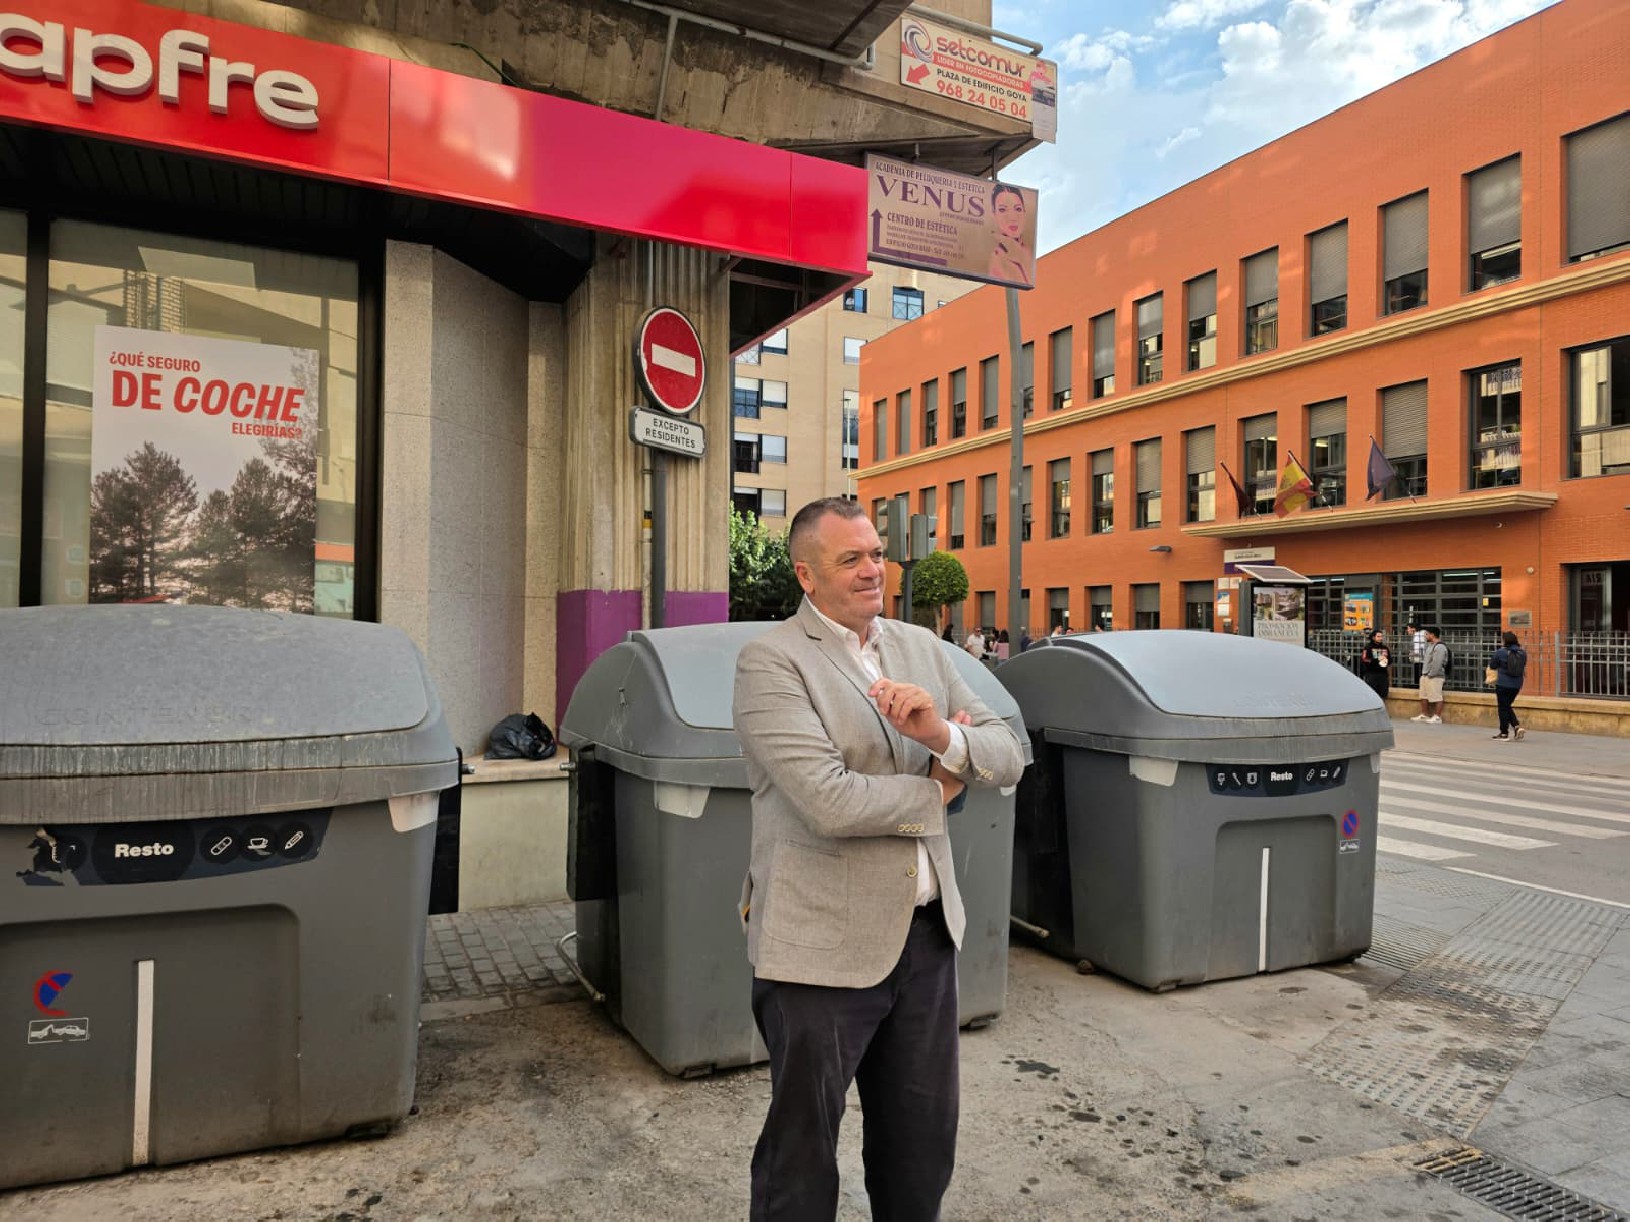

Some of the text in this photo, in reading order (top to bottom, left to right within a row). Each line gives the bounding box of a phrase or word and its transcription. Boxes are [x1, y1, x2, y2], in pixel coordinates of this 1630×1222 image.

[937, 68, 1027, 102] PLAZA DE EDIFICIO GOYA
[936, 80, 1026, 119] 968 24 05 04
[875, 161, 905, 176] ACADEMIA
[906, 169, 914, 179] DE
[876, 174, 985, 218] VENUS
[887, 212, 914, 227] CENTRO
[915, 217, 926, 229] DE
[109, 351, 201, 373] ¿QUÉ SEGURO
[111, 369, 305, 423] DE COCHE
[645, 427, 696, 449] RESIDENTES
[653, 418, 690, 436] EXCEPTO
[1270, 770, 1294, 782] Resto
[114, 842, 175, 858] Resto
